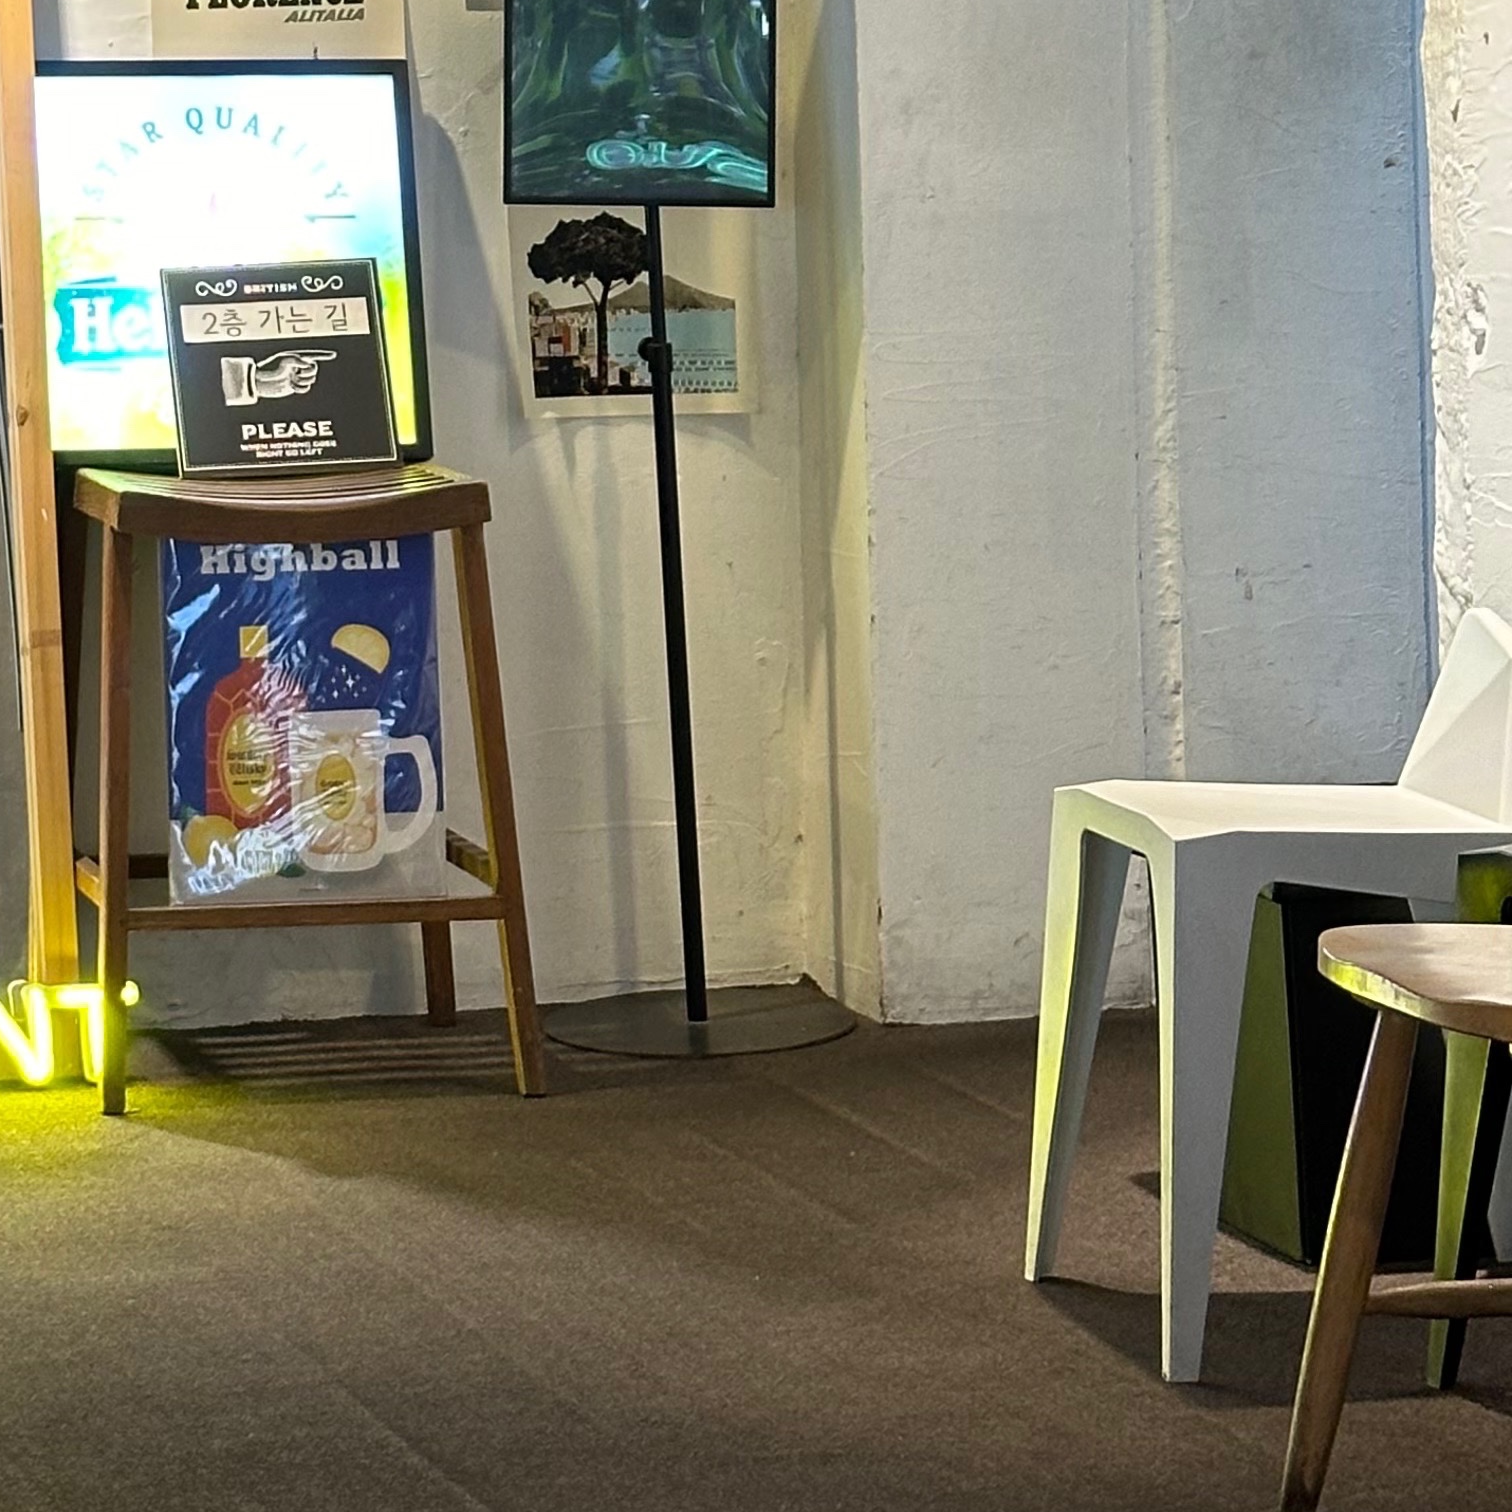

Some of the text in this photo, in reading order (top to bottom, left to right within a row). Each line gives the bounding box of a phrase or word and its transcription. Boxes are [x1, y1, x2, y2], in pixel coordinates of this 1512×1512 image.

[283, 7, 366, 24] ALITALIA
[243, 282, 298, 295] BRITISH
[202, 302, 350, 337] 2층 가는 길
[241, 420, 334, 440] PLEASE
[199, 539, 401, 582] Highball
